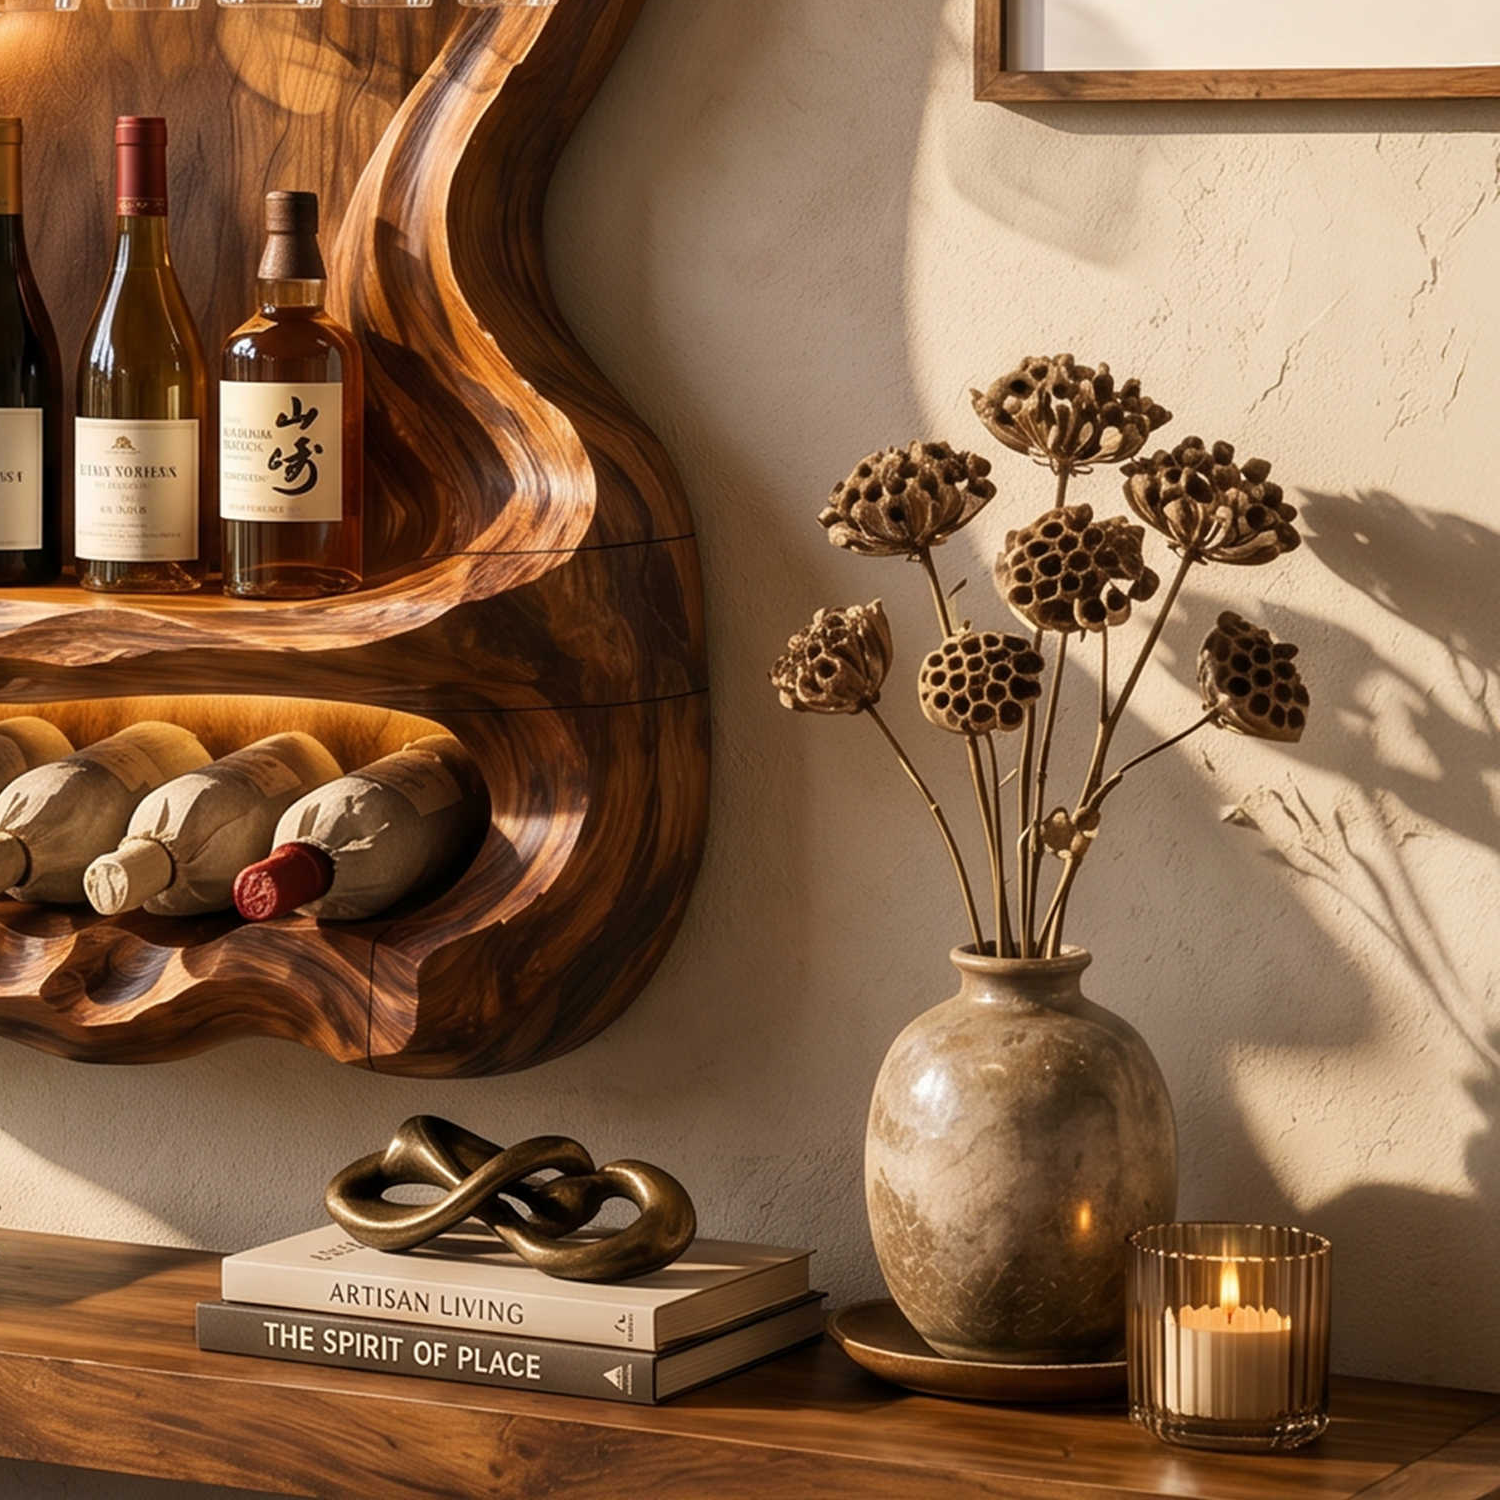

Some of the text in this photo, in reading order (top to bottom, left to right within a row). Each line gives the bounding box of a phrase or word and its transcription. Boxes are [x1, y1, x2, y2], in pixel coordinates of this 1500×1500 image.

[329, 1282, 525, 1325] ARTISAN LIVING
[262, 1321, 542, 1380] THE SPIRIT OF PLACE
